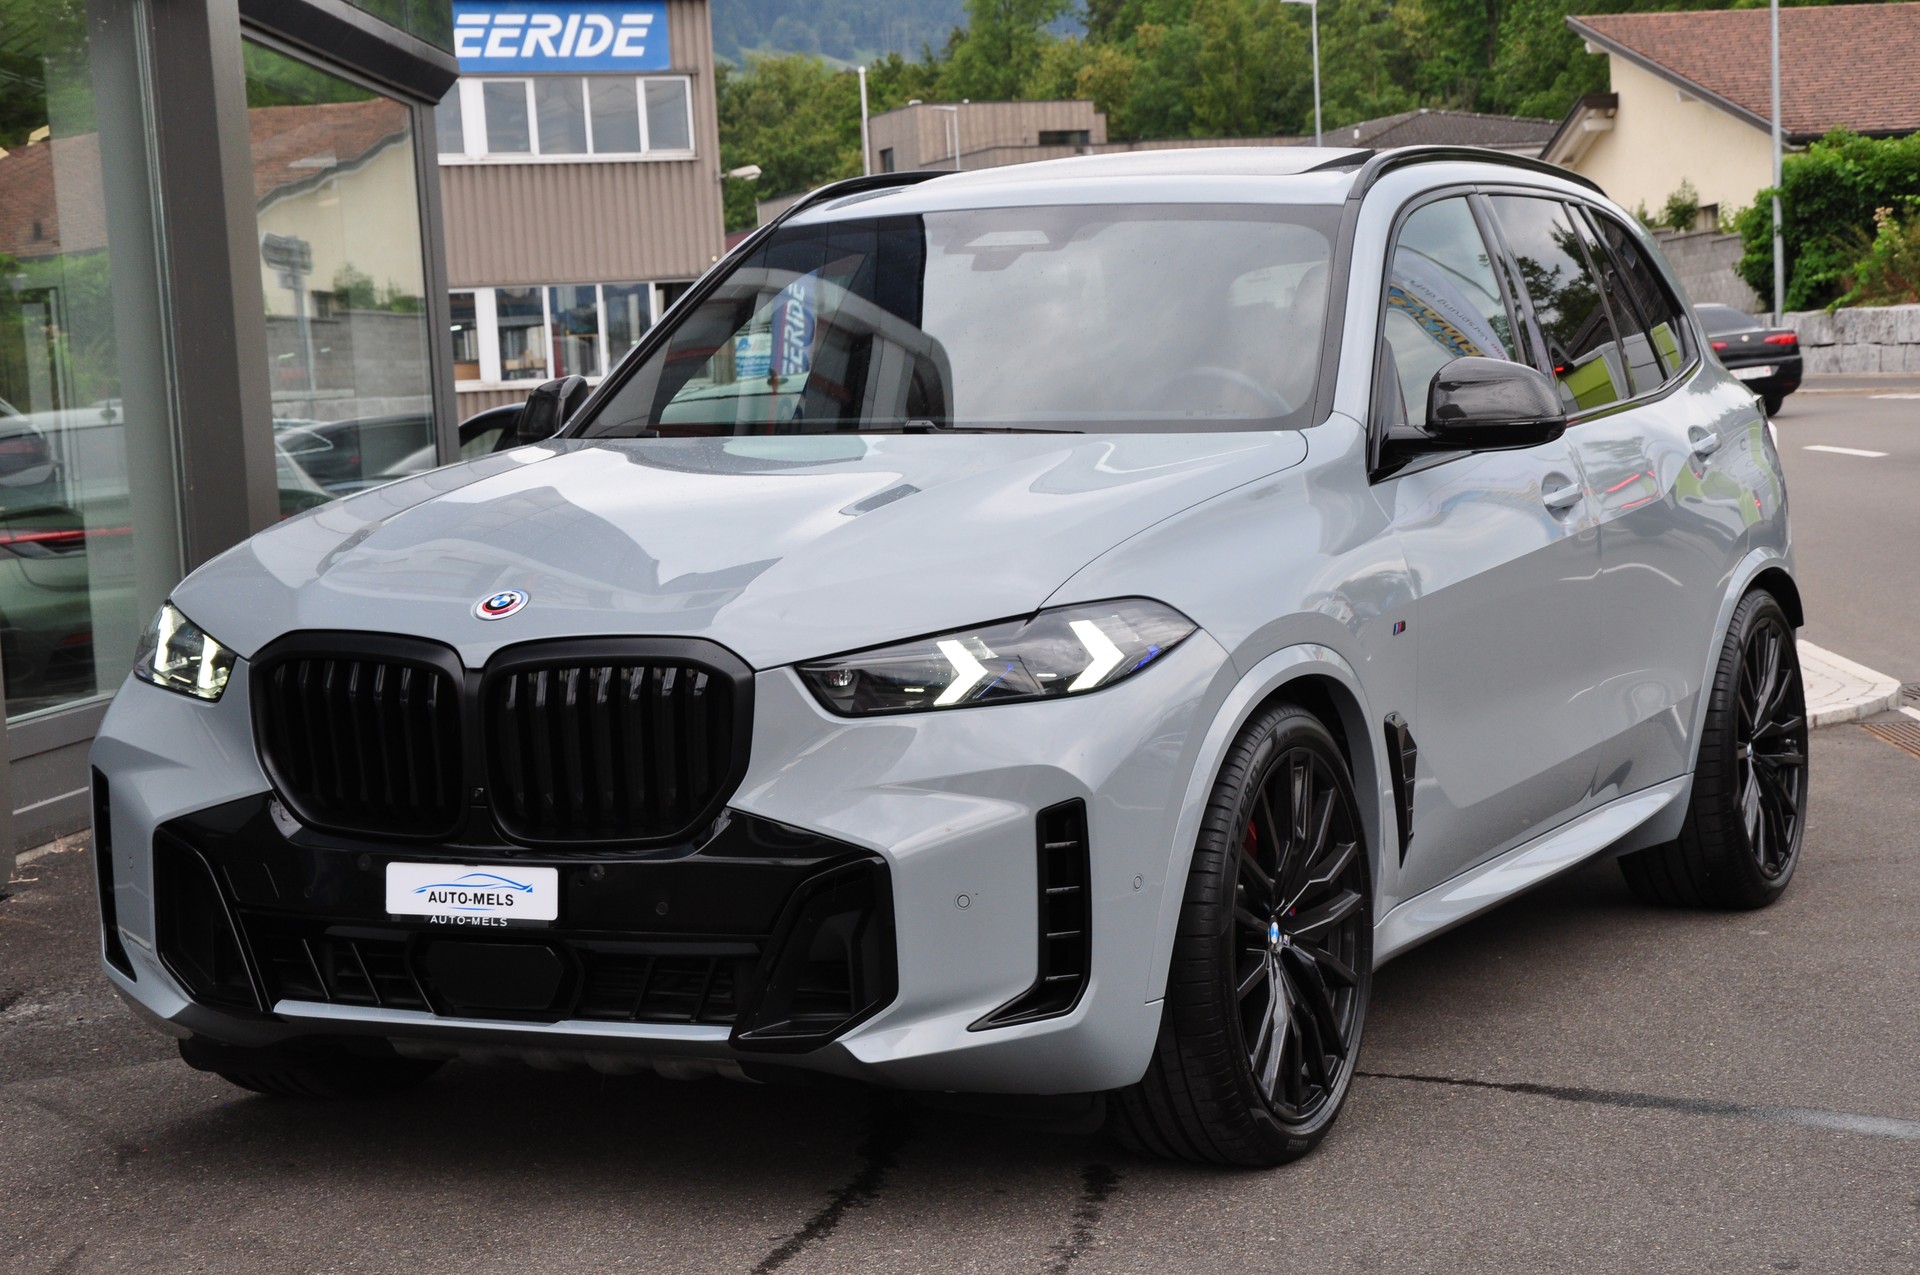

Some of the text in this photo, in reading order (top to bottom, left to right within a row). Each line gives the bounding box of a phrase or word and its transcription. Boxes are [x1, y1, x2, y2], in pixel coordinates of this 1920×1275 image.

[453, 13, 654, 58] EERIDE
[428, 890, 514, 907] AUTO-MELS
[429, 915, 508, 927] AUTO-MELS
